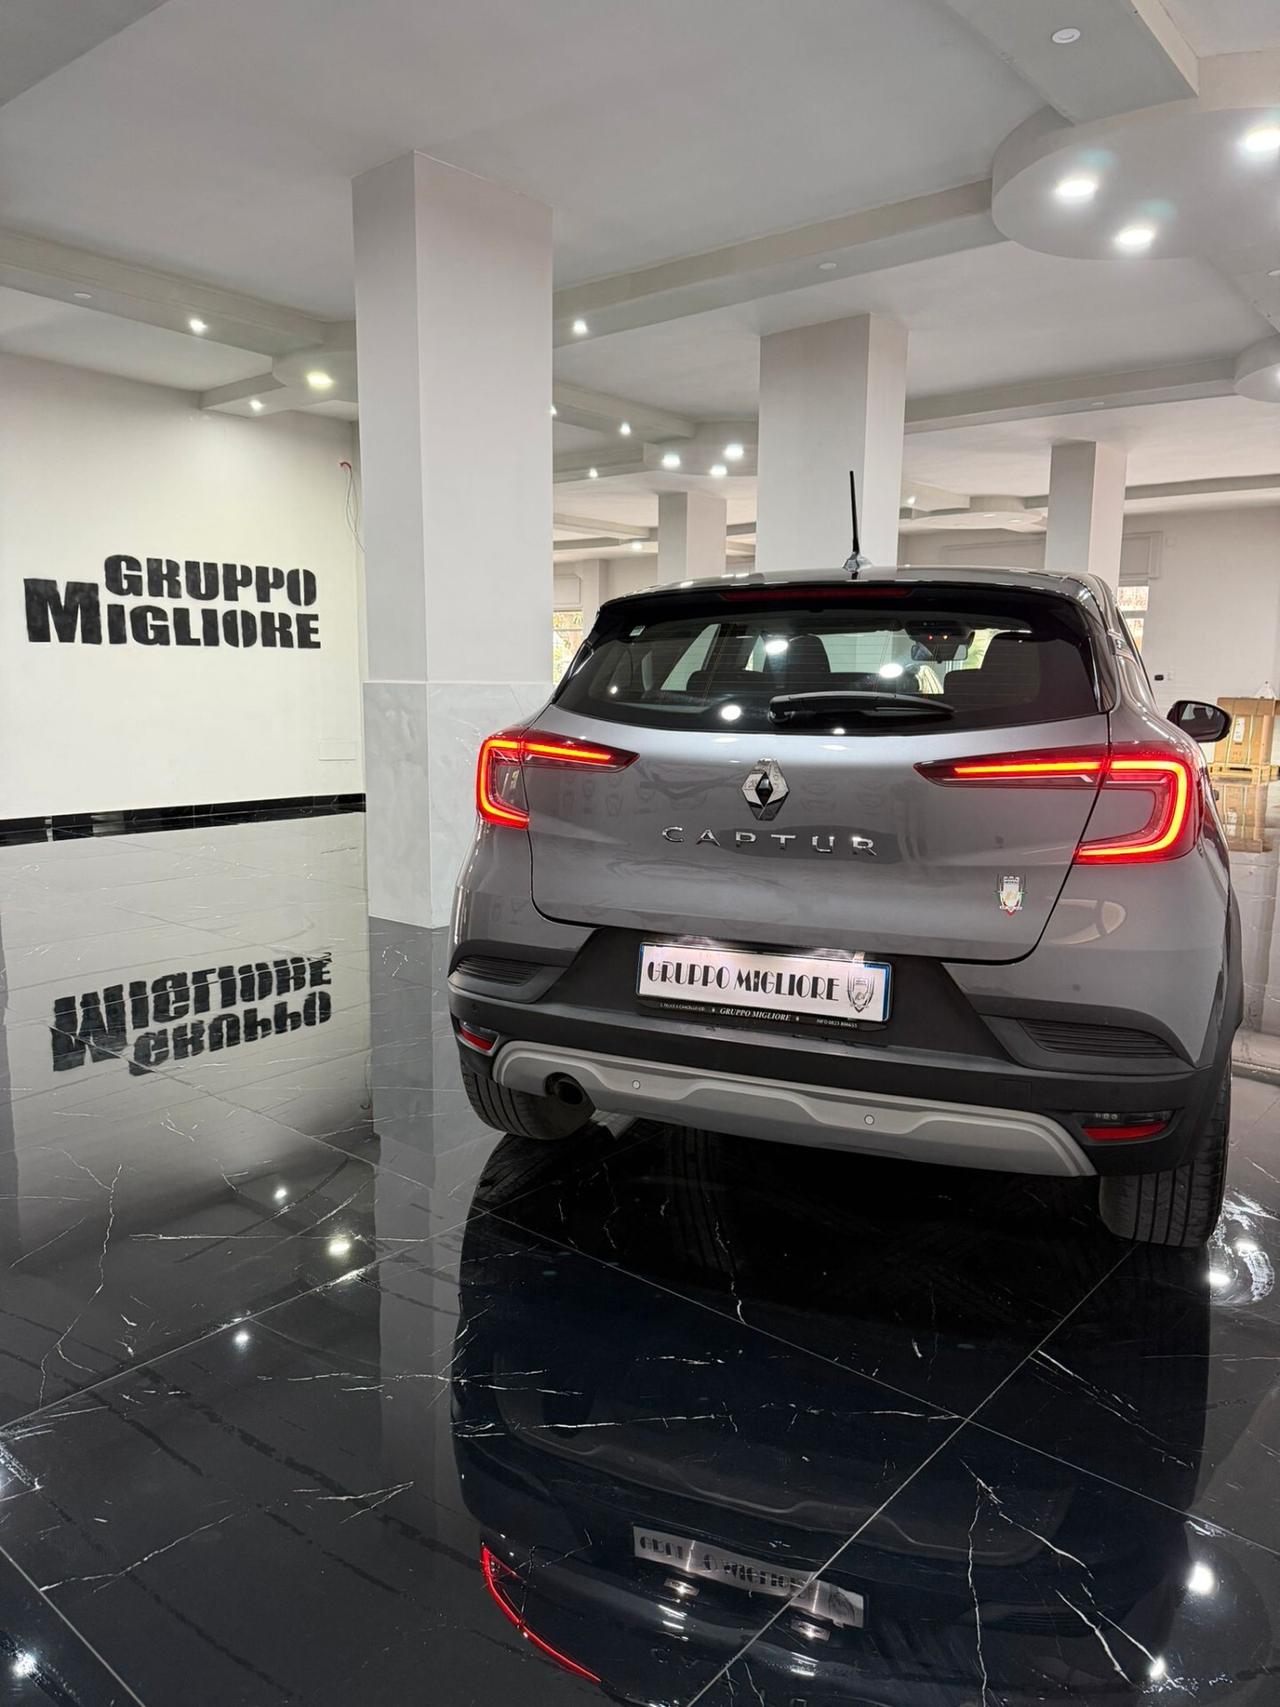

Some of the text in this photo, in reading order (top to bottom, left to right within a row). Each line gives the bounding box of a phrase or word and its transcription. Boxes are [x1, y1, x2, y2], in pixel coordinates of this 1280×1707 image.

[104, 554, 317, 606] GRUPPO
[23, 577, 321, 649] MIGLIORE
[662, 826, 877, 856] CAPTUR
[647, 961, 840, 1002] GRUPPO MIGLIORE
[720, 1008, 791, 1021] GRUPPO MIGLIORE
